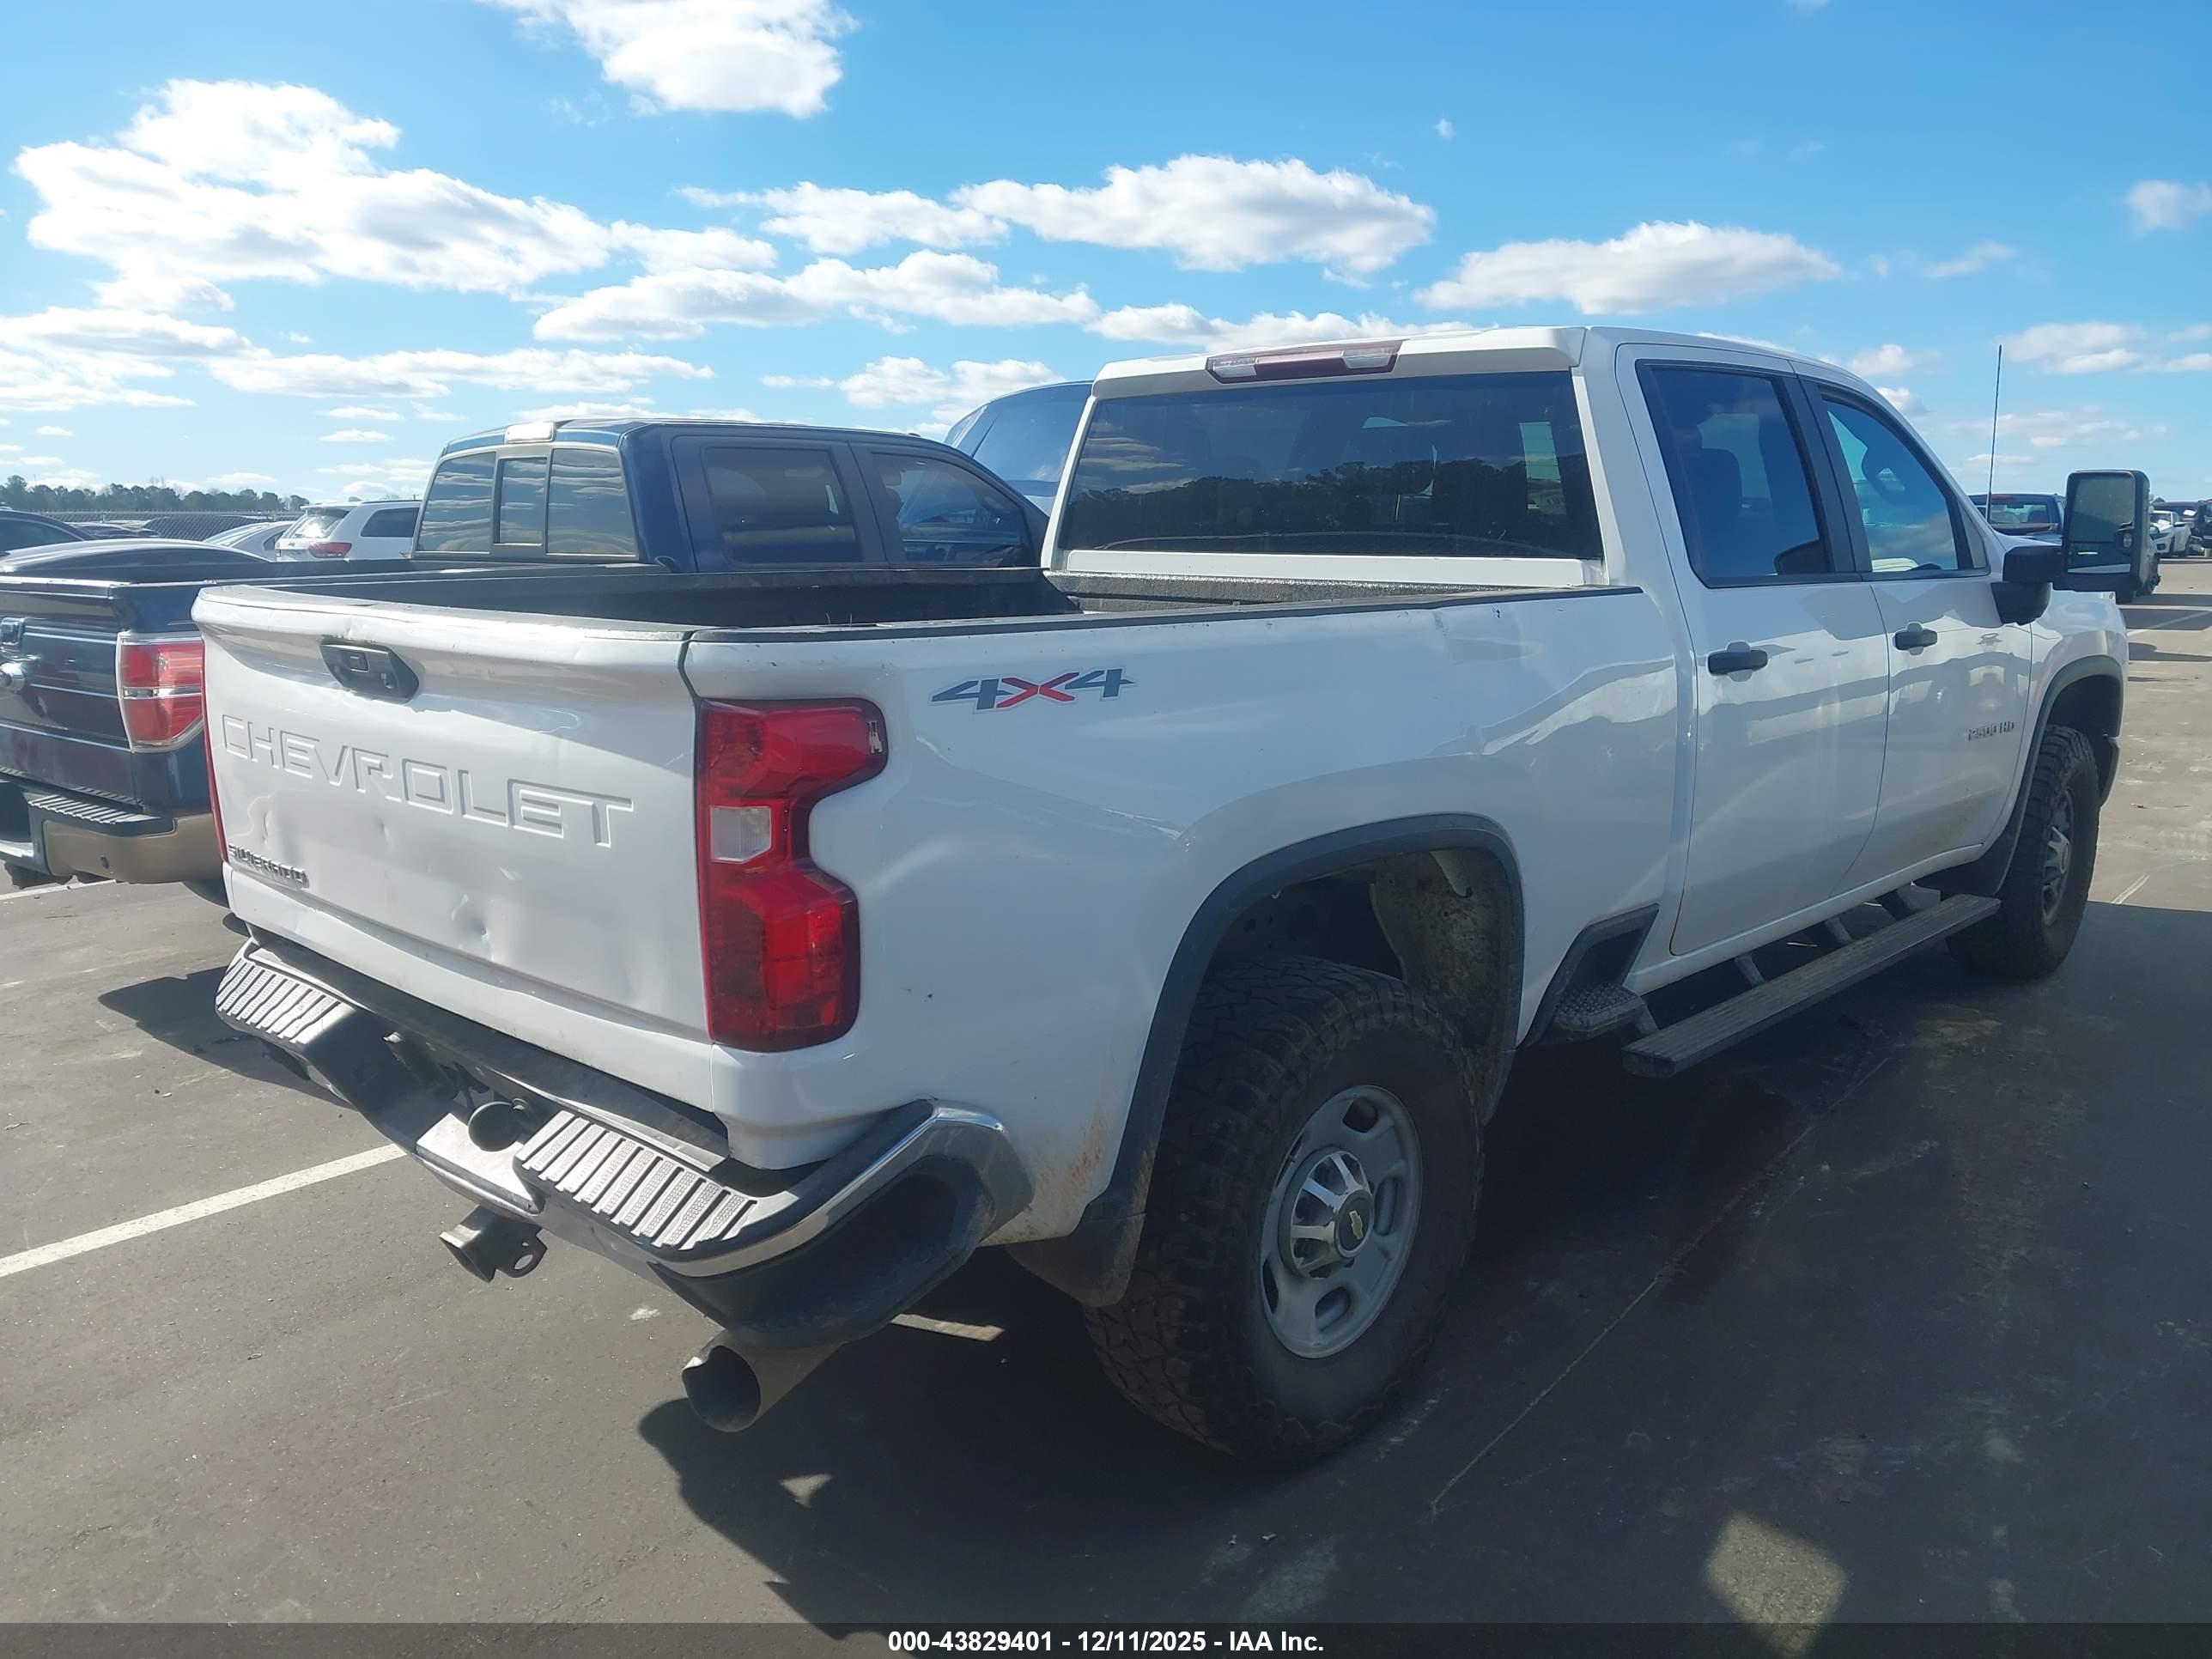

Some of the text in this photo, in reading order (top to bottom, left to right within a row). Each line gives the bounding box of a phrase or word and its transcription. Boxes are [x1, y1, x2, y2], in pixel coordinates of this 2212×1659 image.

[931, 668, 1134, 711] 4X4
[222, 714, 634, 848] CHEVROLET
[228, 843, 310, 889] SILVERADO
